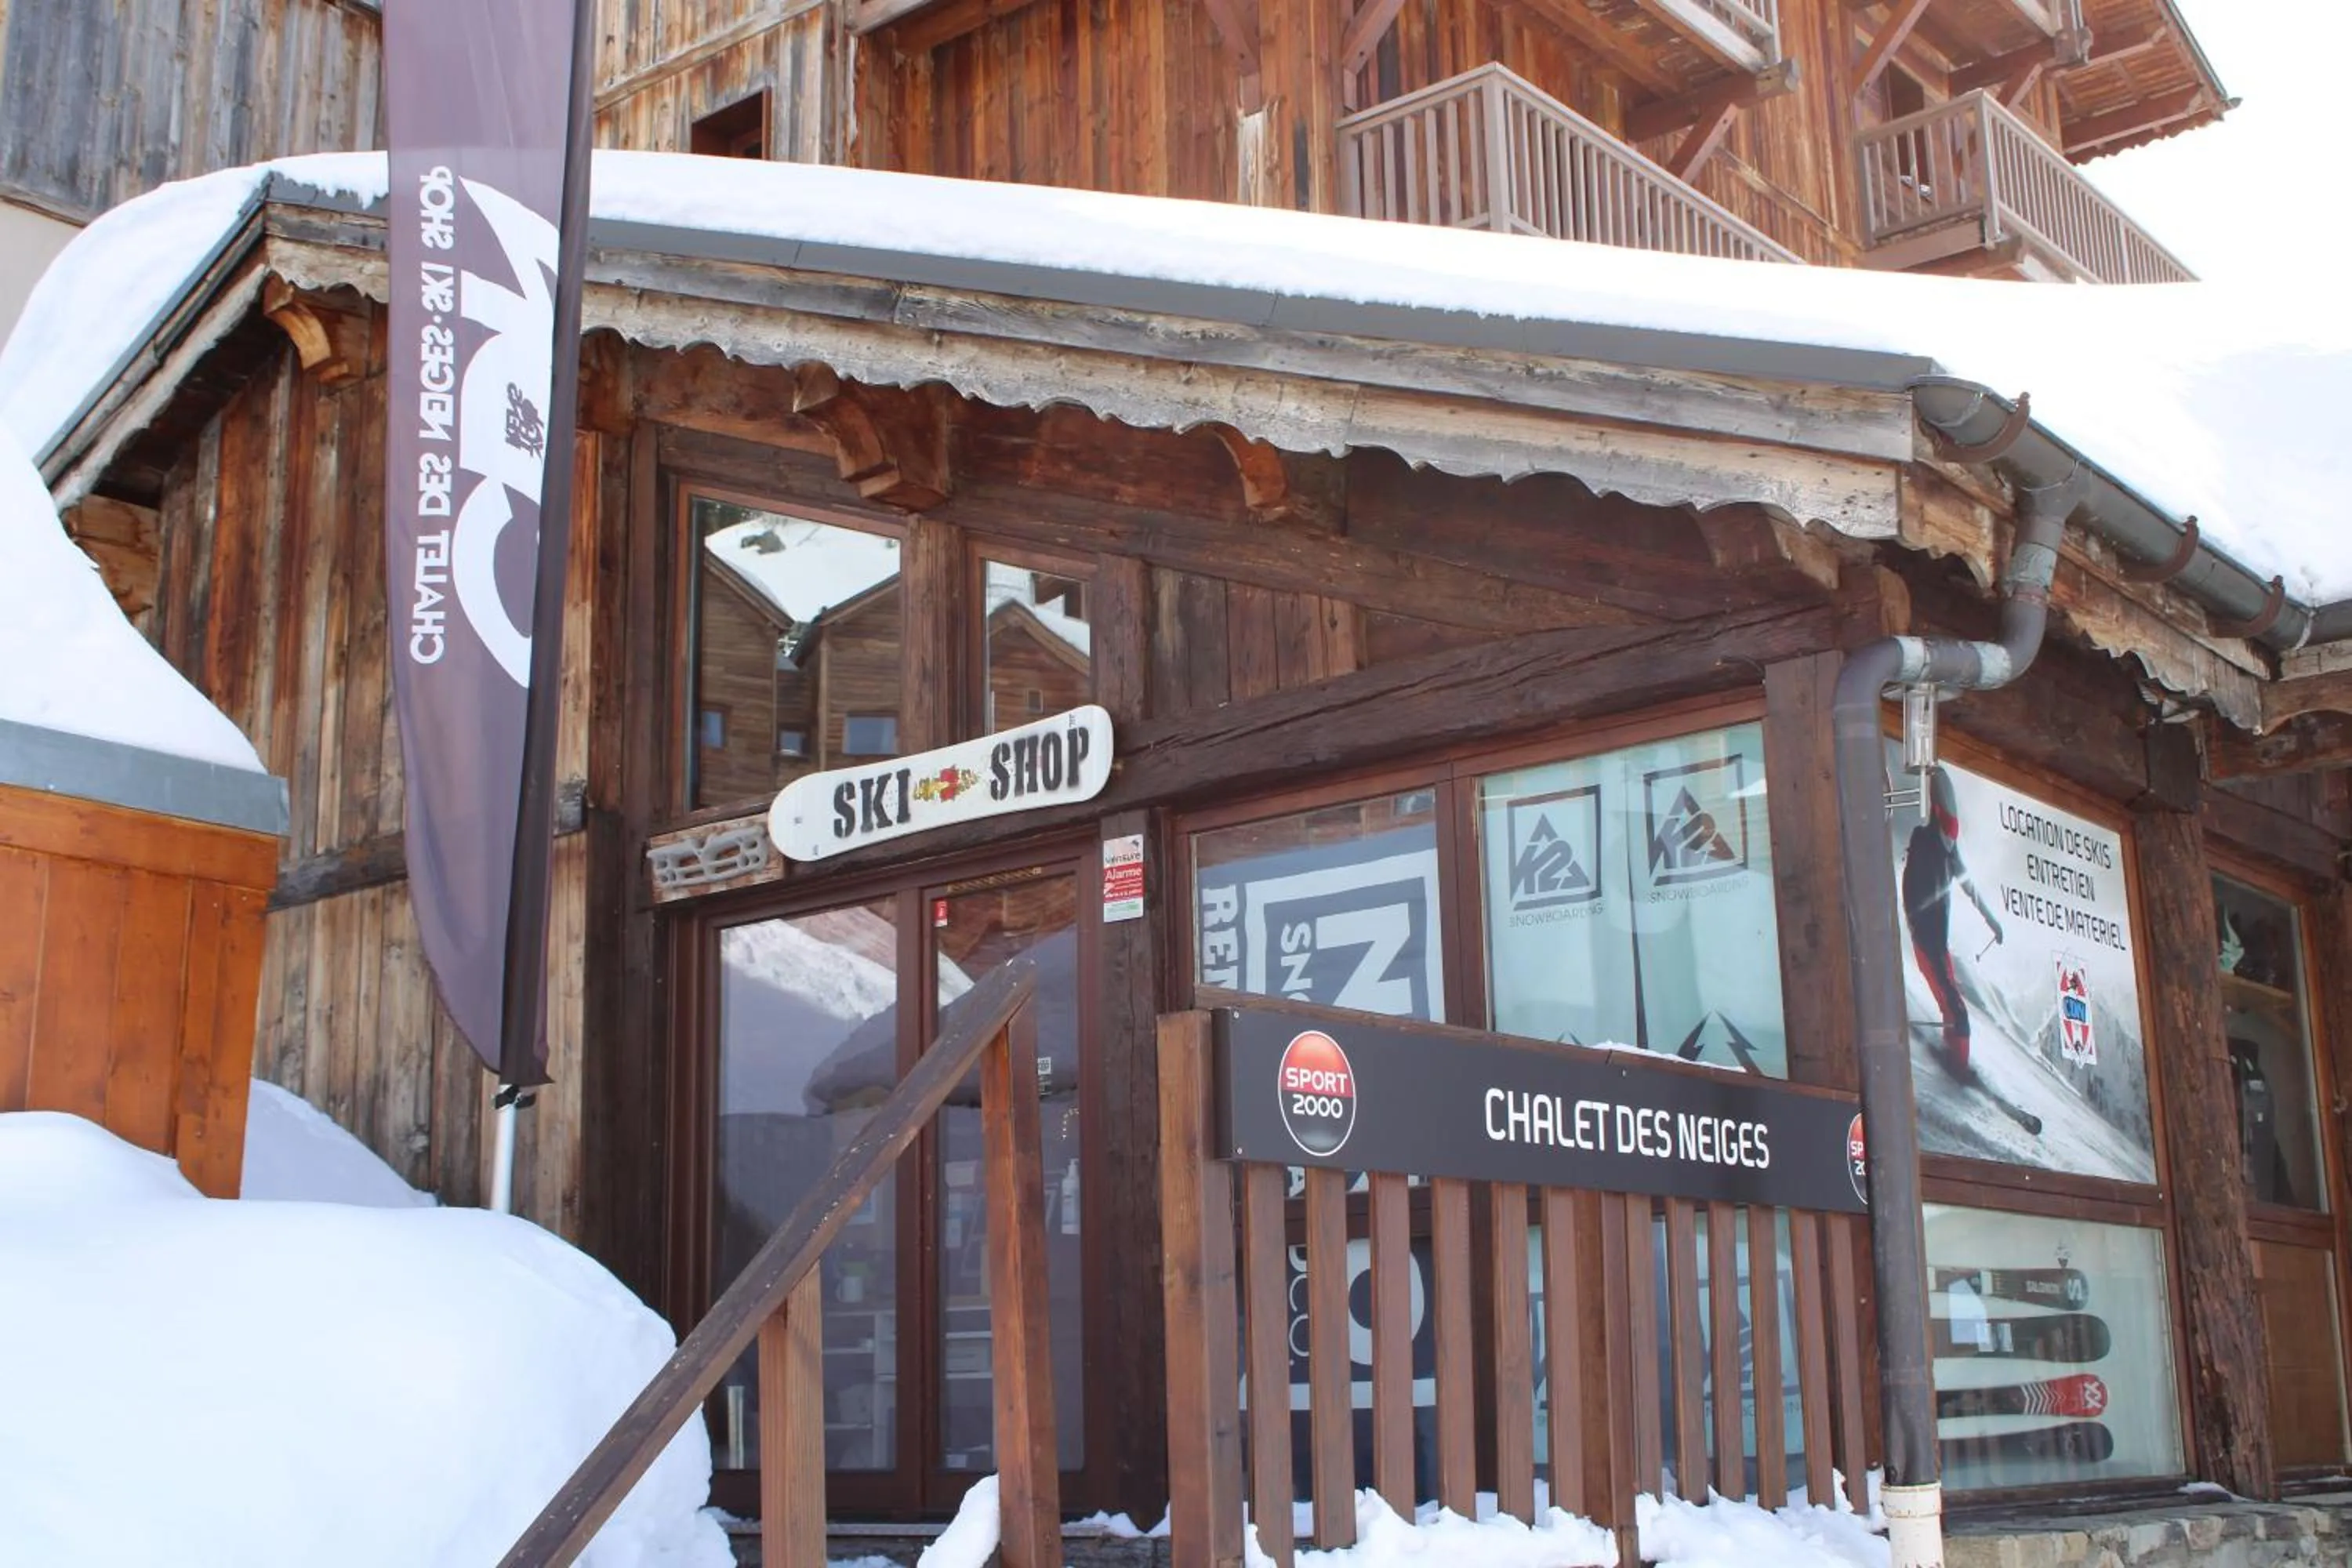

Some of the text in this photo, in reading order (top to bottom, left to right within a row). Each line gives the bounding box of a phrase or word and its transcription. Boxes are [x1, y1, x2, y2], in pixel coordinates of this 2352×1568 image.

[833, 768, 911, 838] SKI
[990, 727, 1090, 800] SHOP
[1999, 802, 2111, 869] LOCATION DE SKIS
[1105, 868, 1142, 880] Alarme
[2026, 854, 2096, 902] ENTRETIEN
[2000, 883, 2127, 951] VENTE DE MATERIEL
[1286, 1067, 1348, 1094] SPORT
[1292, 1094, 1343, 1119] 2000
[1486, 1088, 1770, 1170] CHALET DES NEIGES
